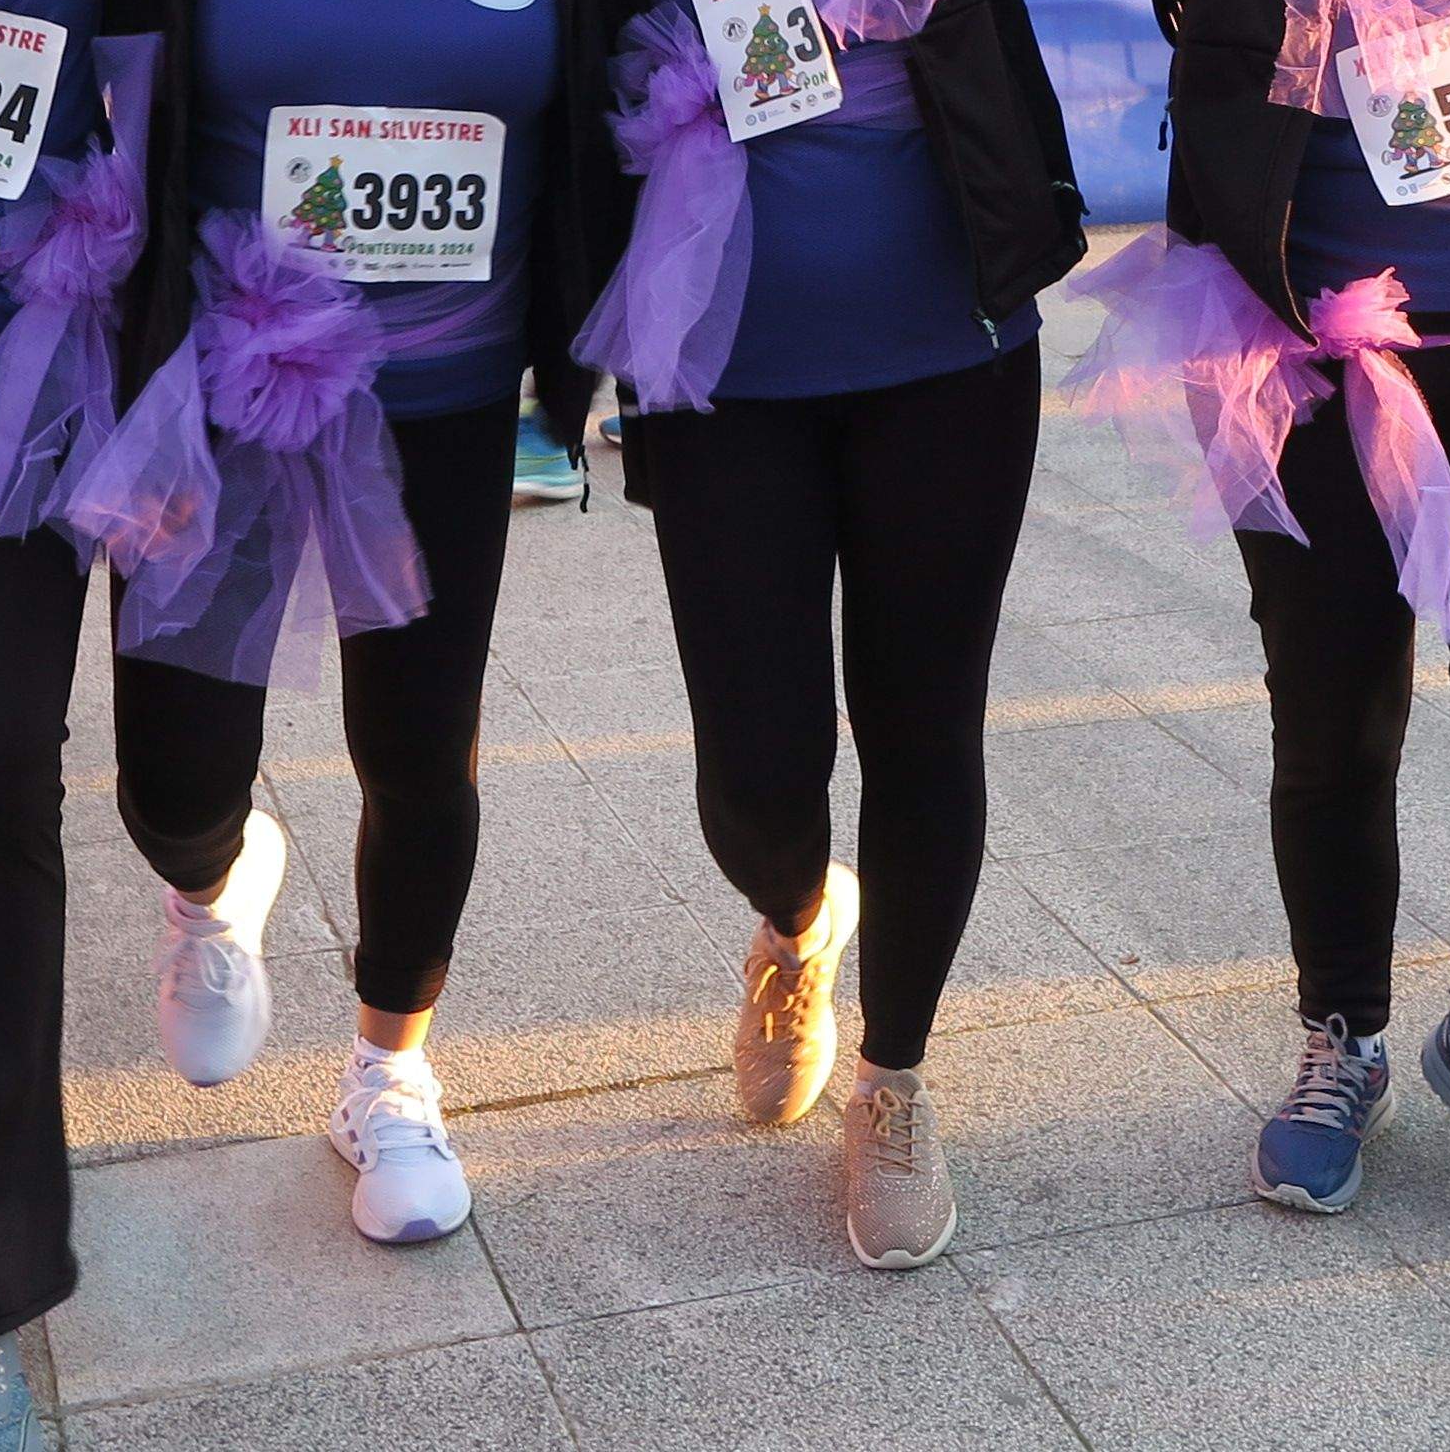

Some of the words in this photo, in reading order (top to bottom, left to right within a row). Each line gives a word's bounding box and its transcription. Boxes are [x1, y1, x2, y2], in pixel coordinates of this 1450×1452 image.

[288, 118, 320, 136] XLI
[328, 118, 372, 138] SAN
[380, 120, 485, 142] SILVESTRE
[352, 172, 486, 231] 3933
[348, 242, 437, 256] PONTEVEDRA
[441, 242, 475, 256] 2024
